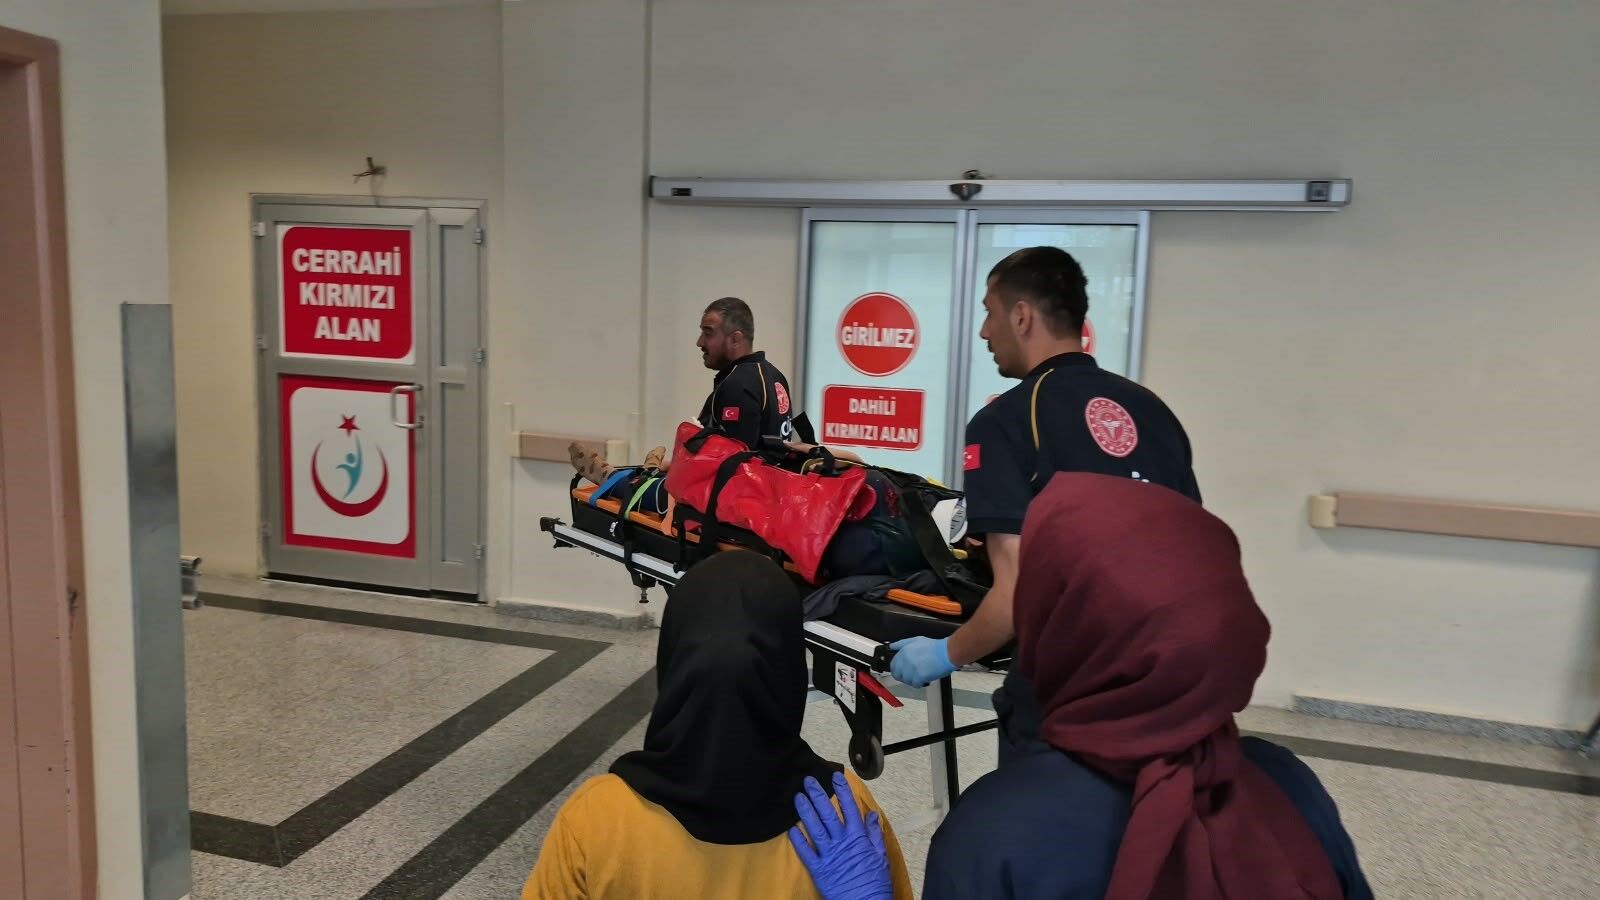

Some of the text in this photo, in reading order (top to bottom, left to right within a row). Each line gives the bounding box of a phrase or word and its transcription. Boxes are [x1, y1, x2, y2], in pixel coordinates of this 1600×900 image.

[291, 246, 401, 276] CERRAHİ
[299, 282, 396, 310] KIRMIZI
[314, 316, 381, 343] ALAN
[841, 321, 915, 349] GİRİLMEZ
[848, 395, 897, 416] DAHİLİ
[825, 422, 919, 444] KIRMIZI ALAN
